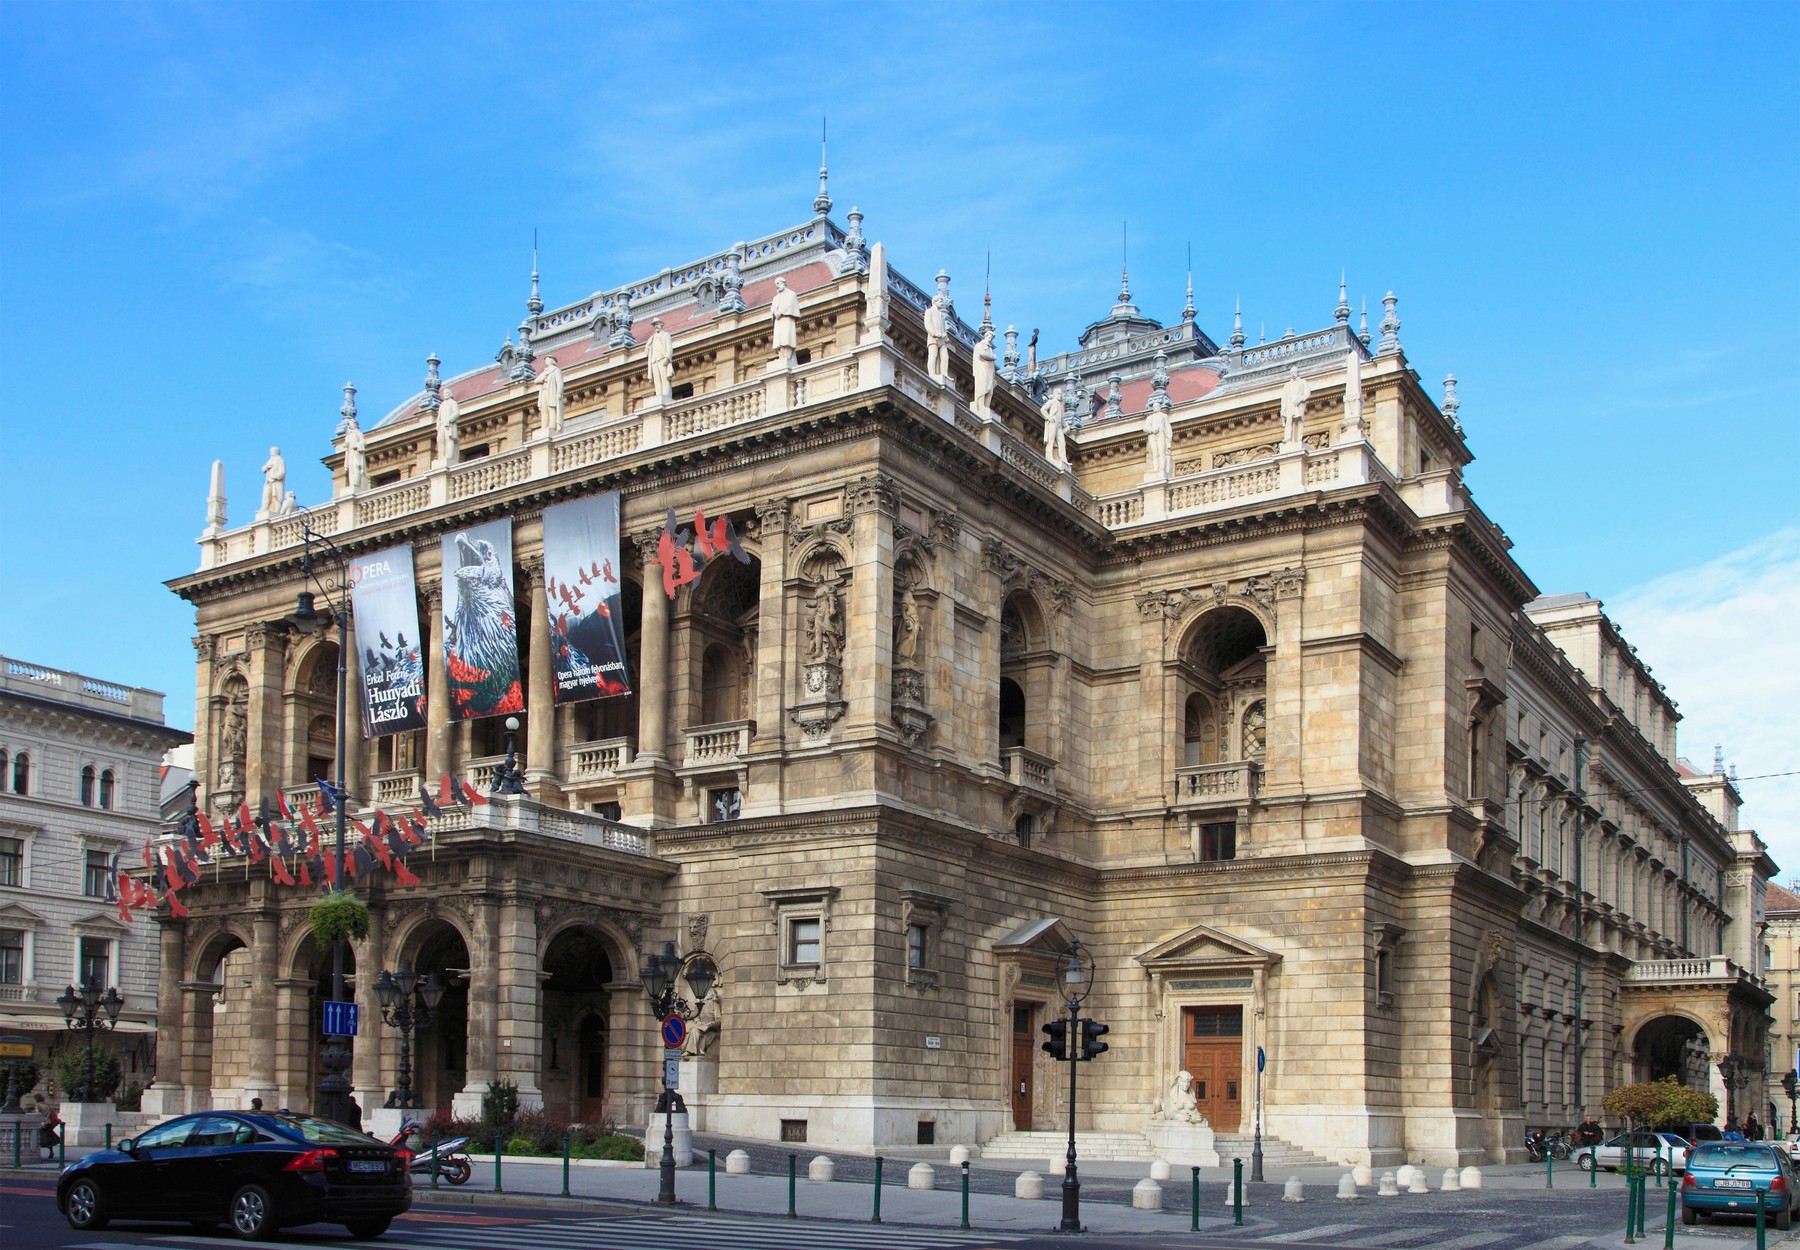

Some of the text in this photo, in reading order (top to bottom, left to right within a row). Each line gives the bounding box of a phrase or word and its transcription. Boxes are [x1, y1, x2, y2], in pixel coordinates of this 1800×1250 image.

[350, 560, 391, 584] OPERA
[366, 669, 409, 686] Erkel Ferenc
[557, 671, 573, 681] Opera
[591, 662, 625, 674] felvonásban,
[368, 680, 421, 704] Hunyadi
[559, 675, 600, 690] magyar nyelven
[369, 698, 408, 724] László
